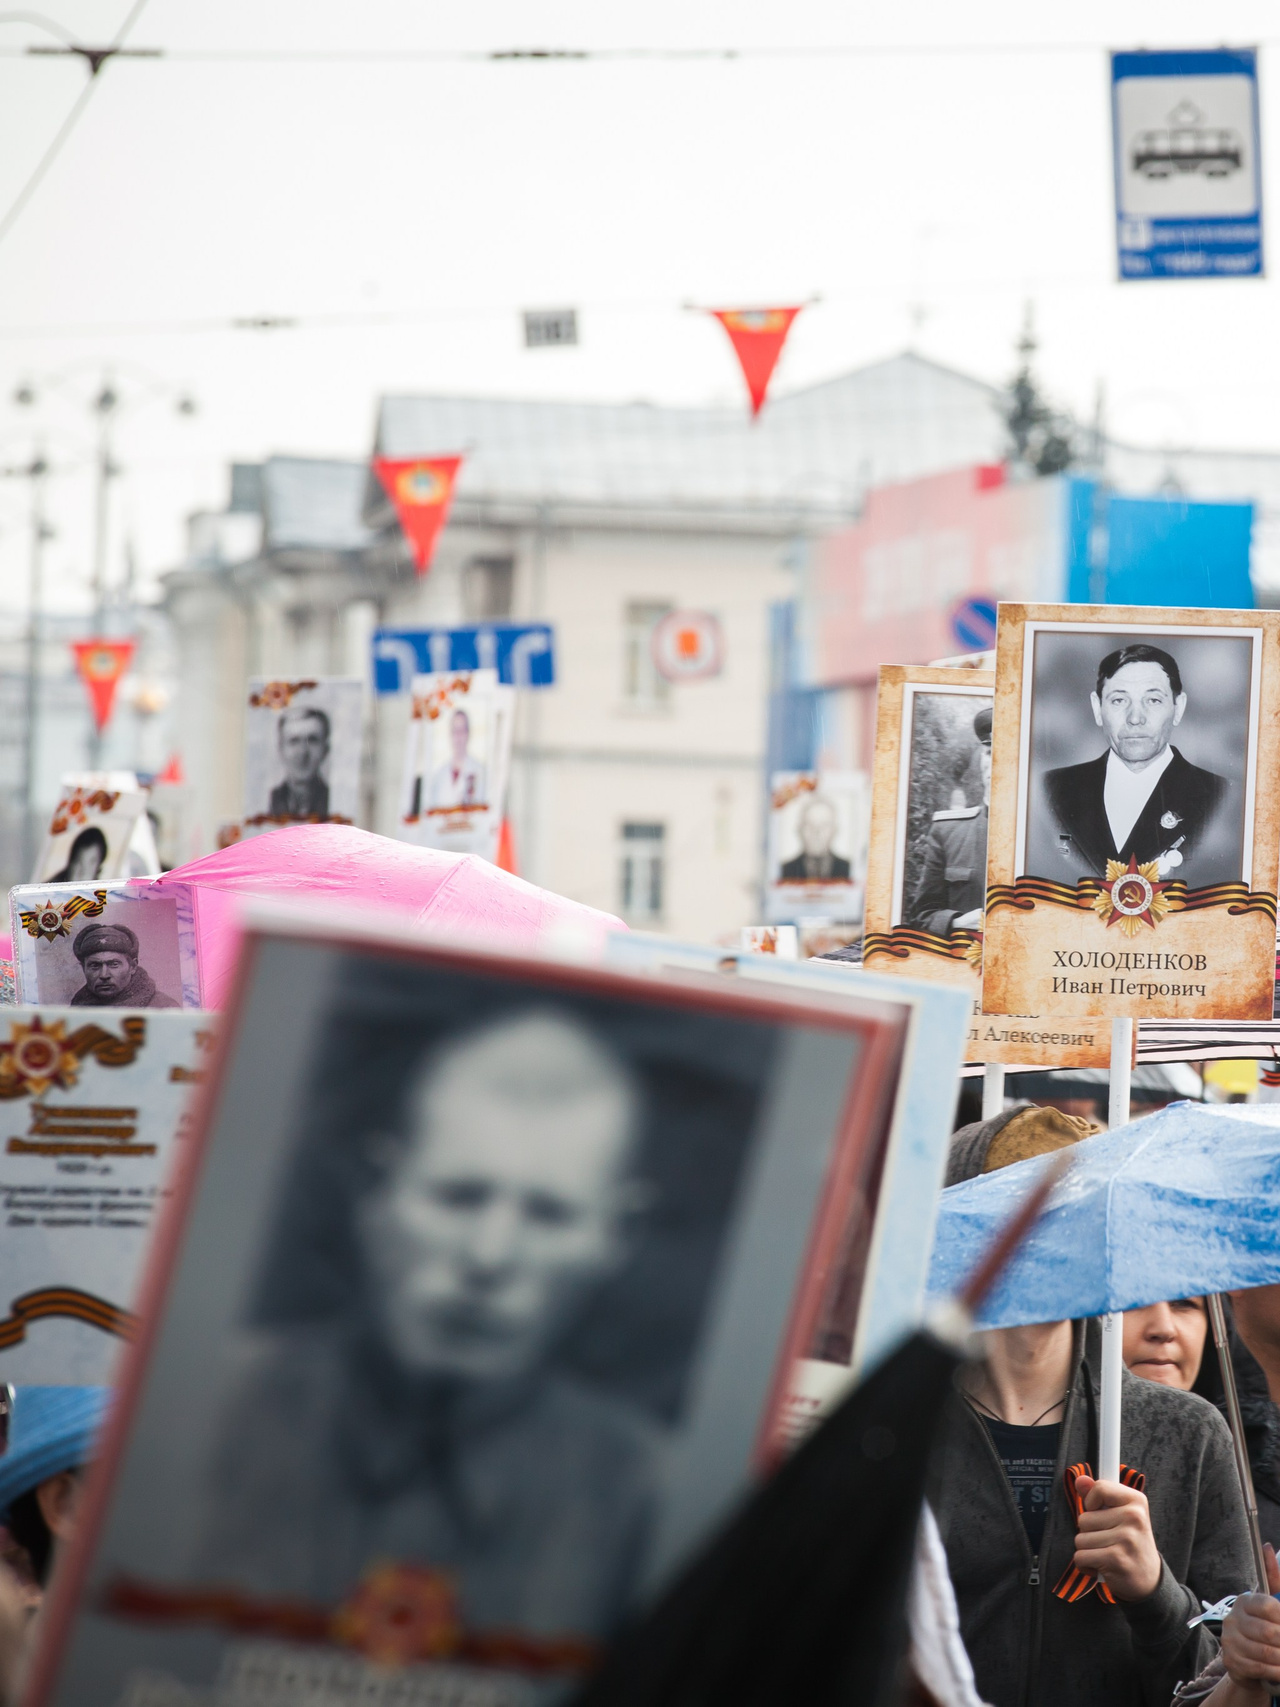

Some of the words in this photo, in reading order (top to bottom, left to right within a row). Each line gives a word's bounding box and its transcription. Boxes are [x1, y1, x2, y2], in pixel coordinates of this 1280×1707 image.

[1052, 950, 1207, 972] ХОЛОДЕНКОВ
[1052, 977, 1103, 995] Иван
[1109, 978, 1207, 1000] Петрович
[983, 1026, 1095, 1047] Алексеевич
